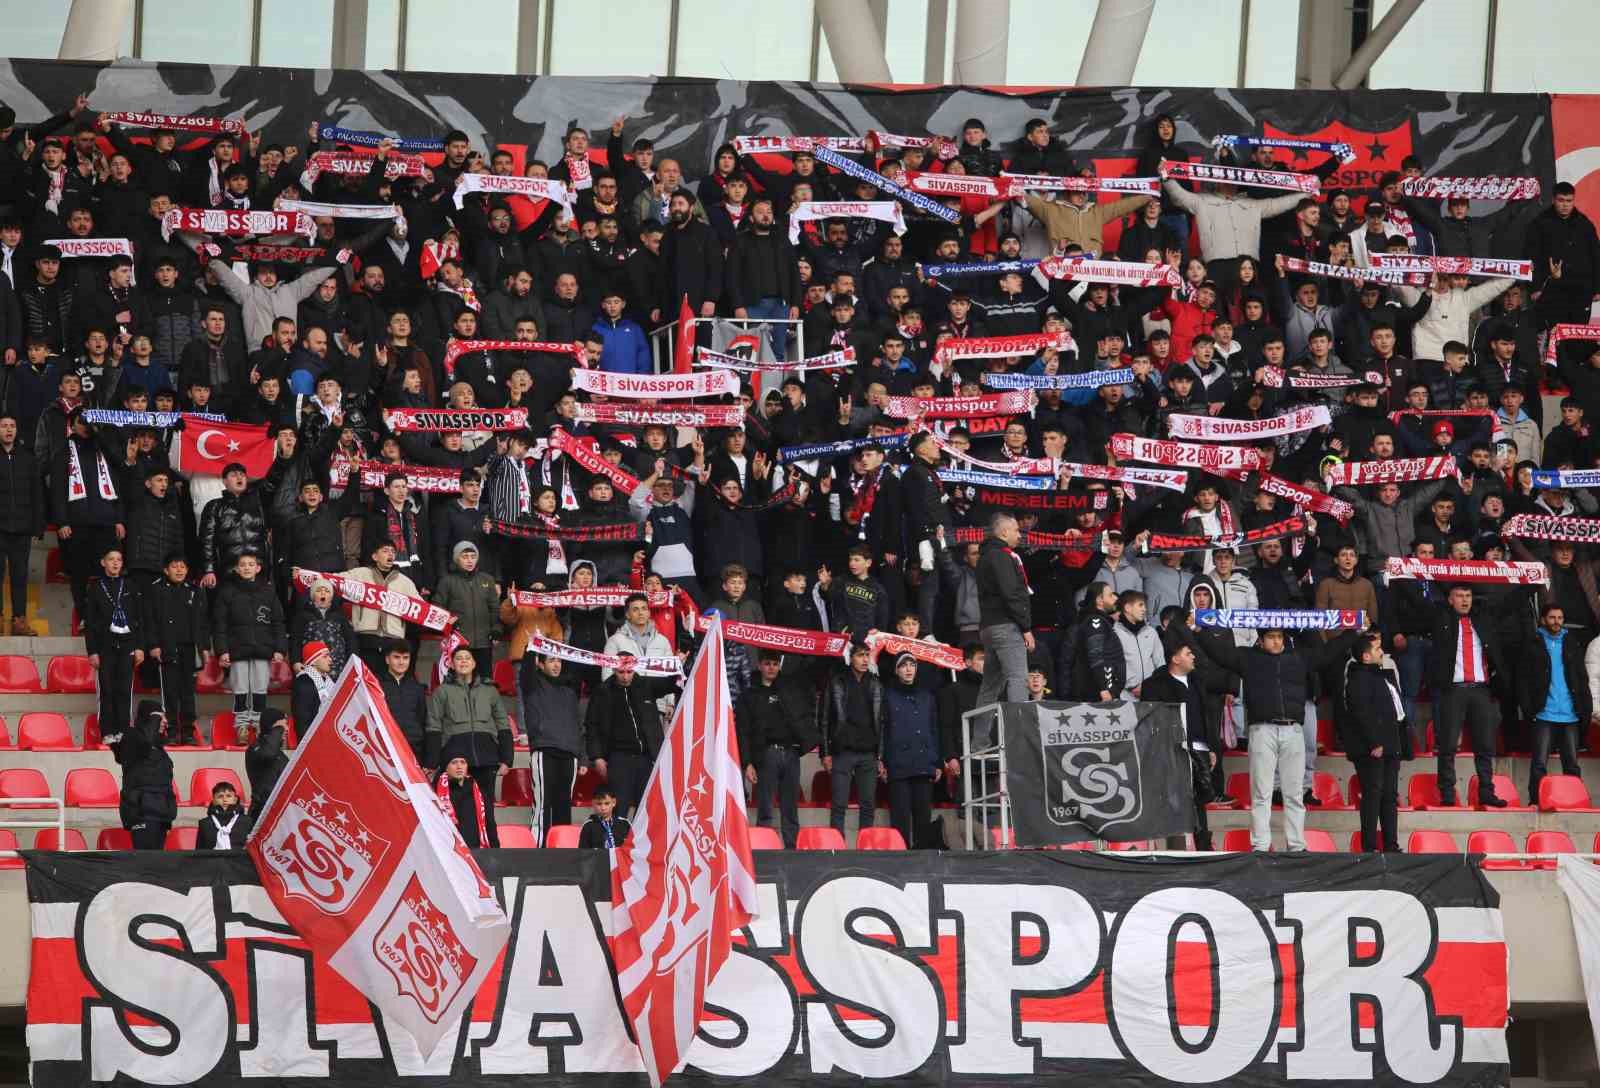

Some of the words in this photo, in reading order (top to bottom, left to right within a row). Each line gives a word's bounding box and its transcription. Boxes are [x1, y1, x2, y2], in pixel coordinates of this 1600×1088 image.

[170, 115, 214, 127] FORZA
[80, 376, 95, 392] 5
[968, 418, 1007, 433] DAY
[1233, 616, 1324, 629] ERZURUM
[340, 721, 366, 748] 1967
[1051, 805, 1080, 819] 1967
[265, 845, 292, 865] 1967
[380, 940, 403, 964] 1967
